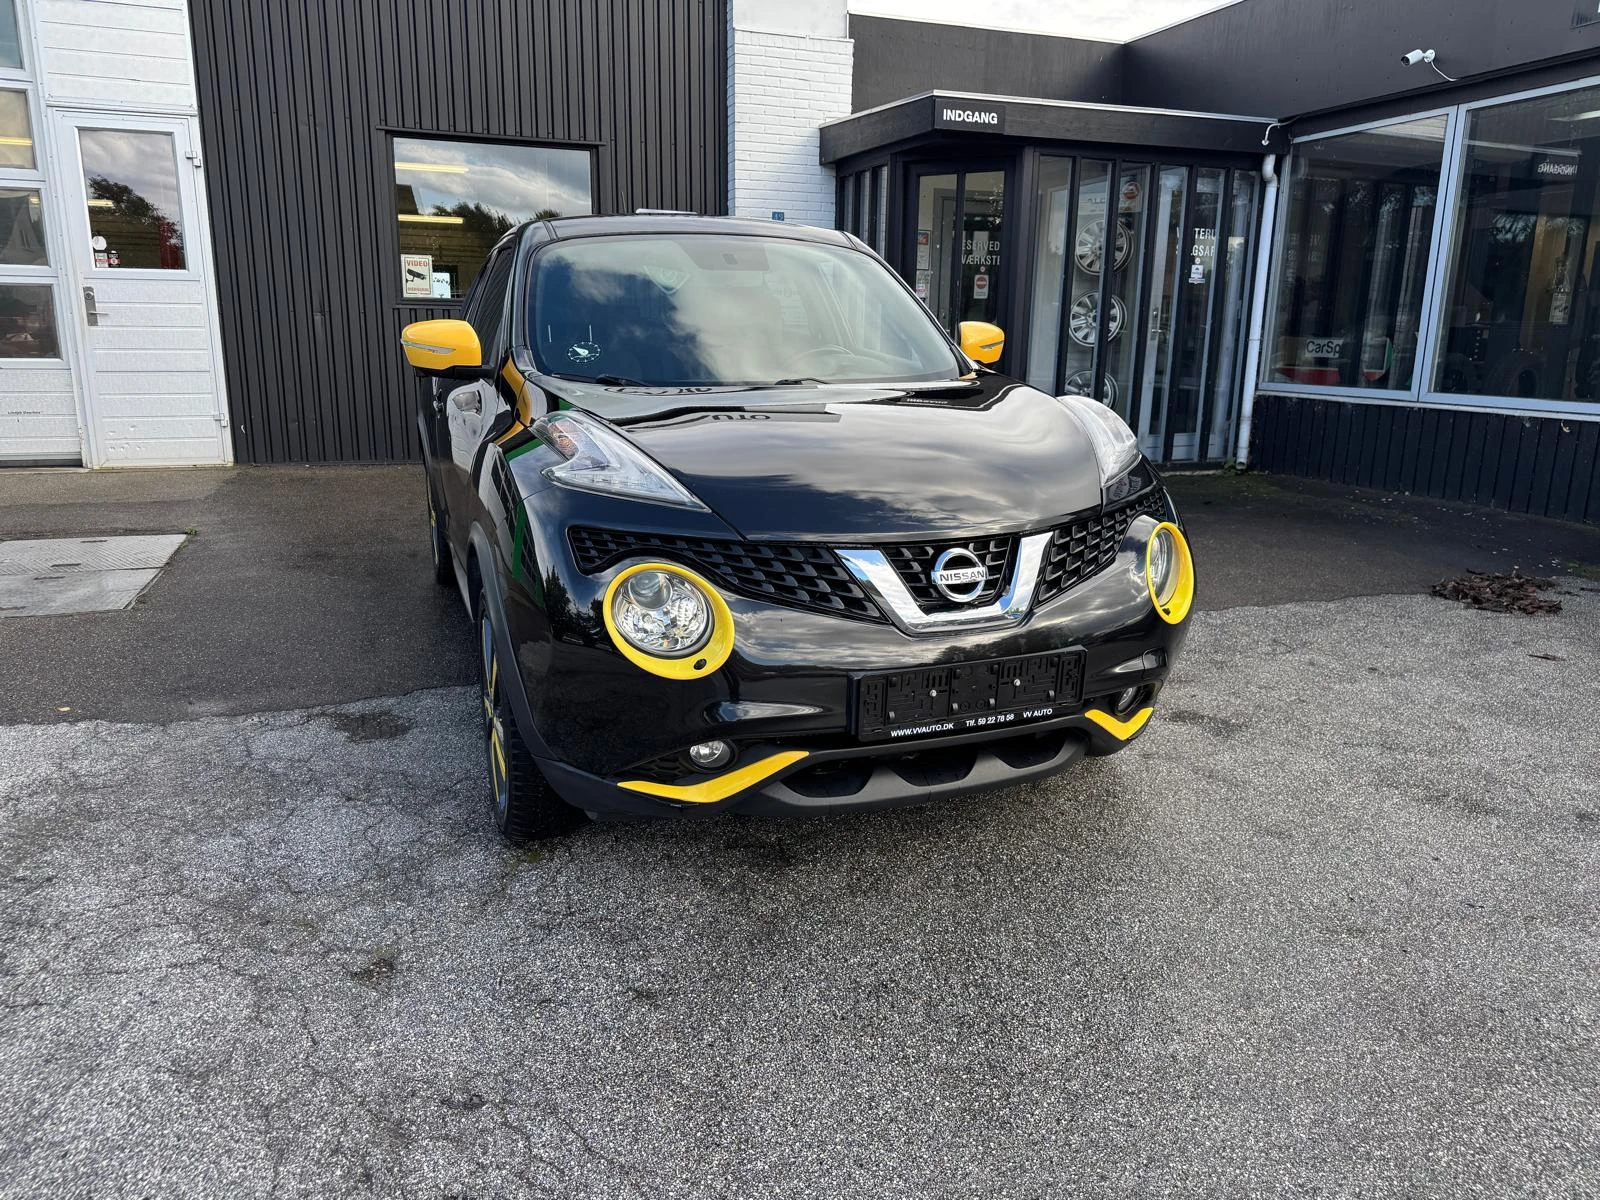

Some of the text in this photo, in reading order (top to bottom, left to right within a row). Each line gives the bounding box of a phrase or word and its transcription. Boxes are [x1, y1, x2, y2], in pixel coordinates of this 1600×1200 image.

[943, 108, 998, 124] INDGANG
[940, 570, 985, 581] NISSAN
[890, 722, 954, 737] WWW.VVAUTO.DK
[987, 716, 996, 724] 22
[1033, 708, 1053, 717] AUTO
